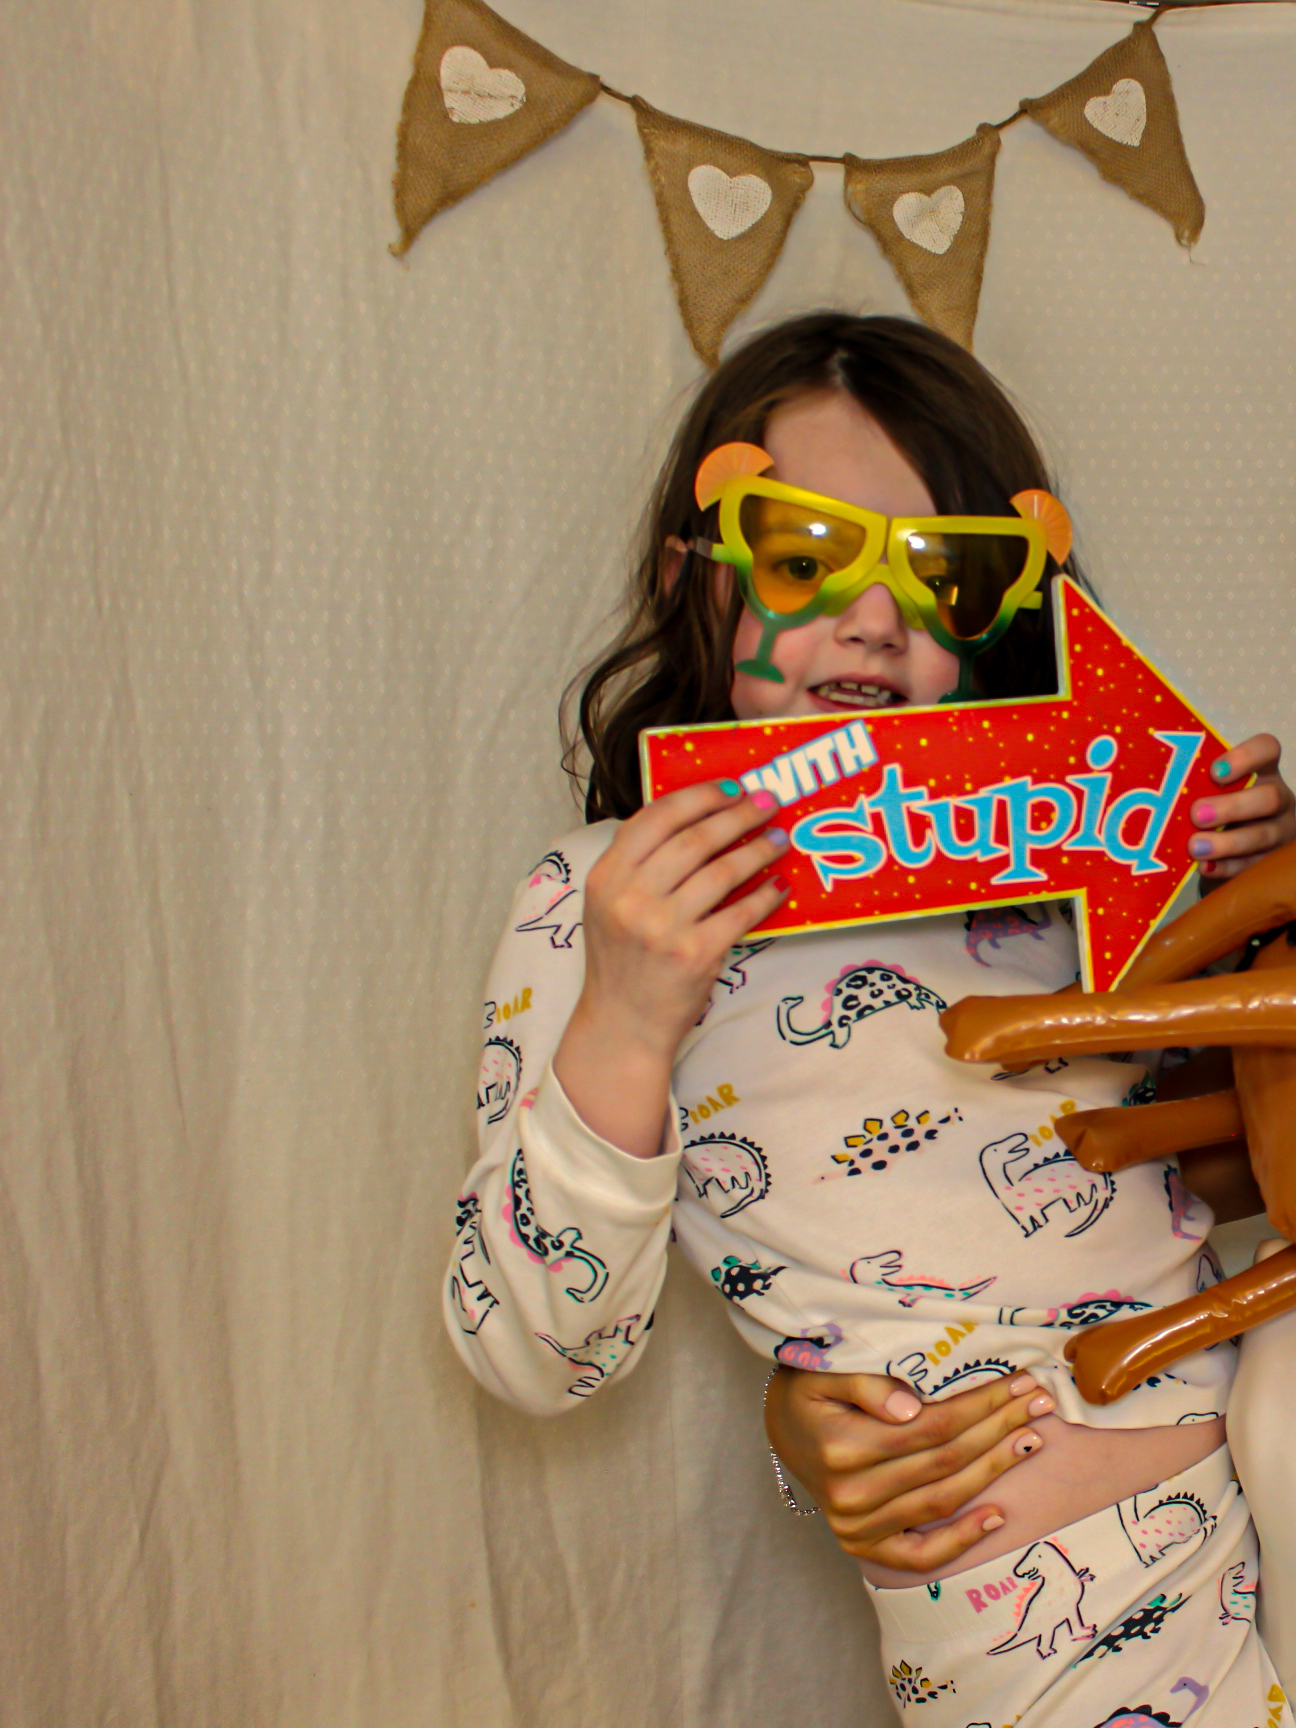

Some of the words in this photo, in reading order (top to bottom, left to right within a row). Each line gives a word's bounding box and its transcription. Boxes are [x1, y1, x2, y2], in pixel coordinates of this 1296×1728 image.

[740, 718, 879, 807] WITH
[790, 730, 1206, 891] stupid
[965, 1576, 1018, 1613] ROAR
